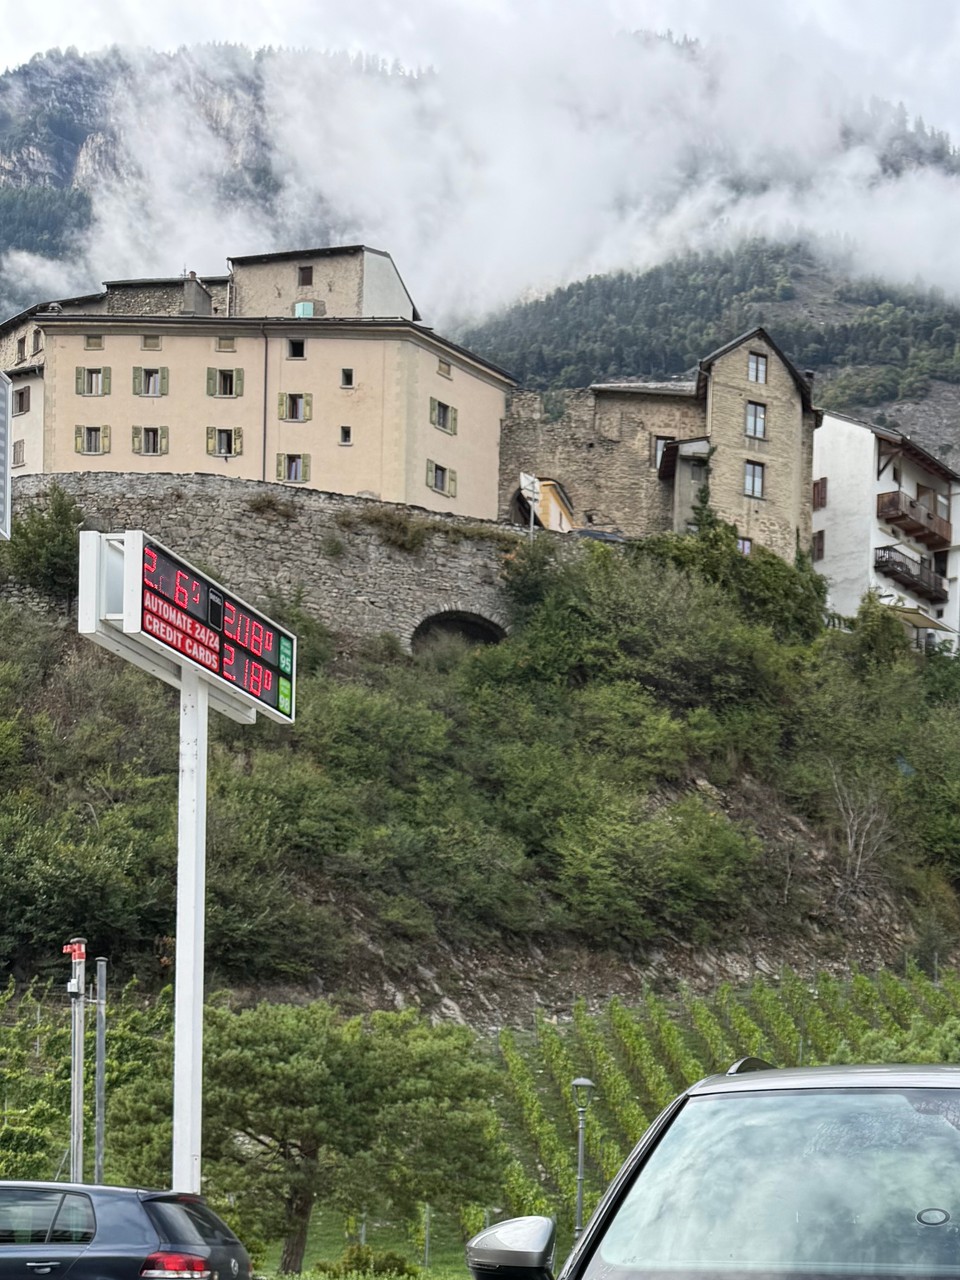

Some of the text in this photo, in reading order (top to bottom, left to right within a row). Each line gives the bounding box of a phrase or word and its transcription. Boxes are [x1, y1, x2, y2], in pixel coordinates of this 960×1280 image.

[144, 592, 220, 651] AUTOMATE 24/24
[145, 616, 218, 670] CREDIT CARDS
[280, 654, 291, 672] 95
